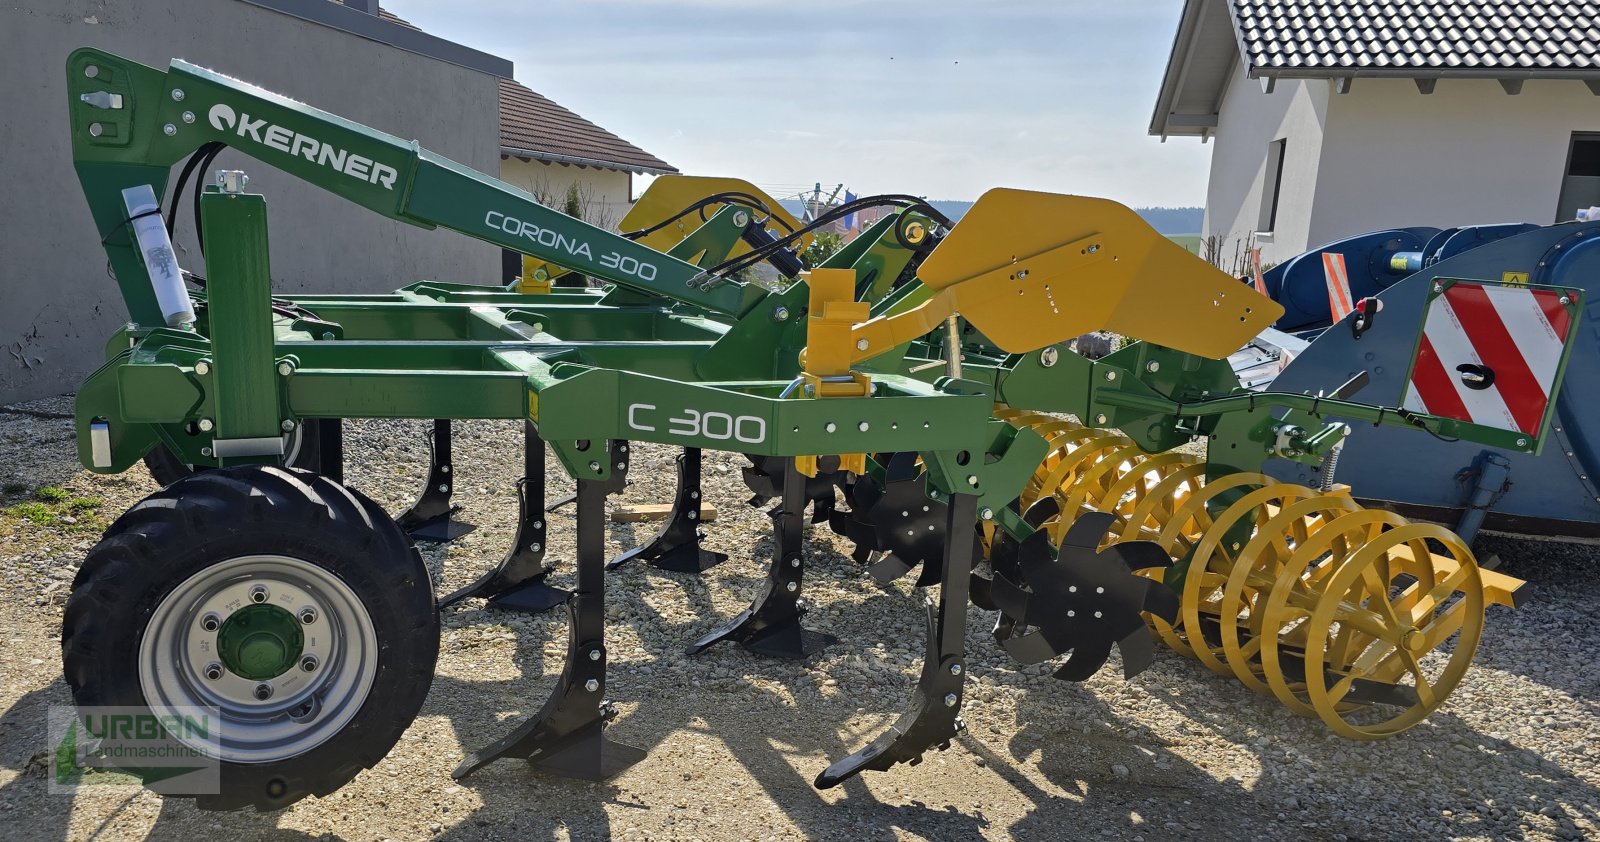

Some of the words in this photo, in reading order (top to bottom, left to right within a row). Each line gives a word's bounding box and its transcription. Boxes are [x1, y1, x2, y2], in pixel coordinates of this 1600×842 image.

[236, 112, 398, 191] KERNER
[485, 210, 593, 262] CORONA
[599, 251, 658, 282] 300
[628, 403, 657, 432] C
[669, 408, 766, 444] 300
